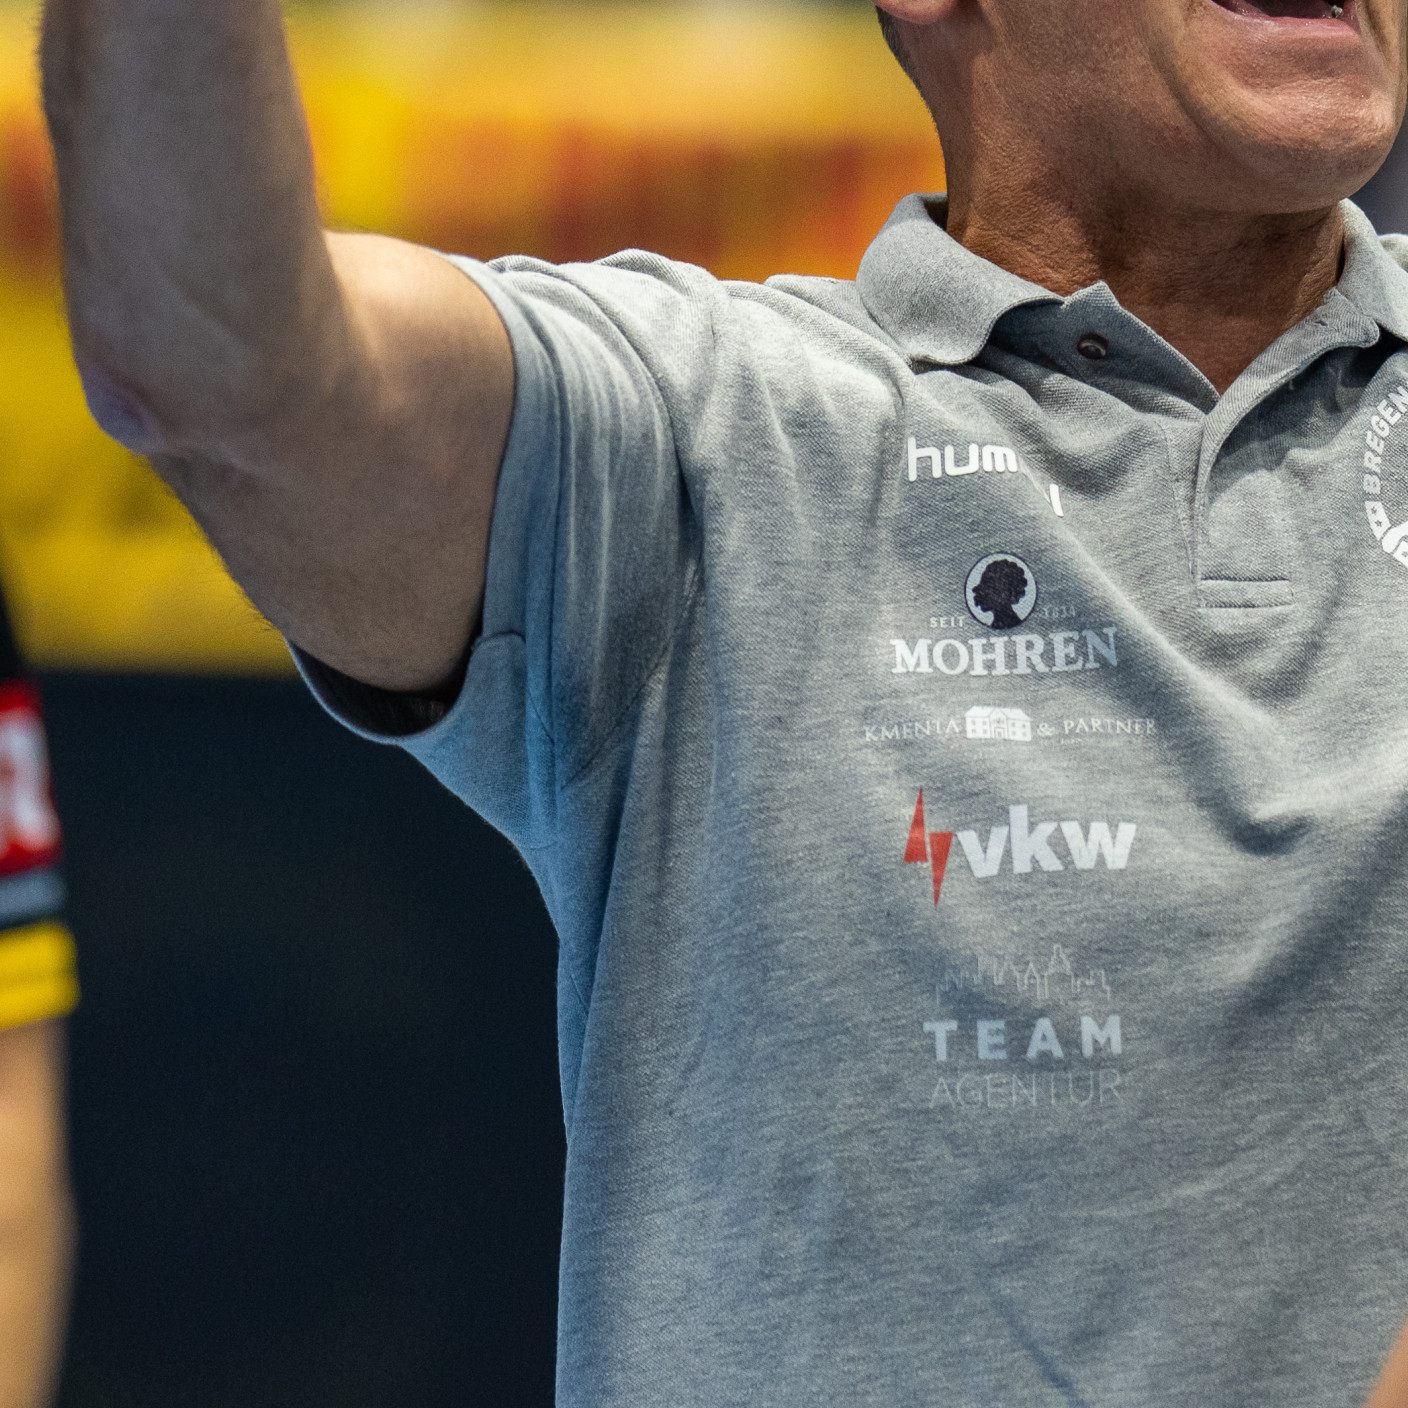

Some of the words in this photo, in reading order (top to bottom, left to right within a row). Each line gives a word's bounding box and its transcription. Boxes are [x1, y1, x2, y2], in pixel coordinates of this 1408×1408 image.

[929, 615, 966, 628] SEIT
[889, 625, 1118, 676] MOHREN
[863, 718, 961, 742] KMENTA
[1037, 722, 1056, 737] &
[1063, 718, 1155, 735] PARTNER
[956, 804, 1137, 879] vkw
[922, 1014, 1123, 1062] TEAM
[928, 1067, 1125, 1110] AGENTUR
